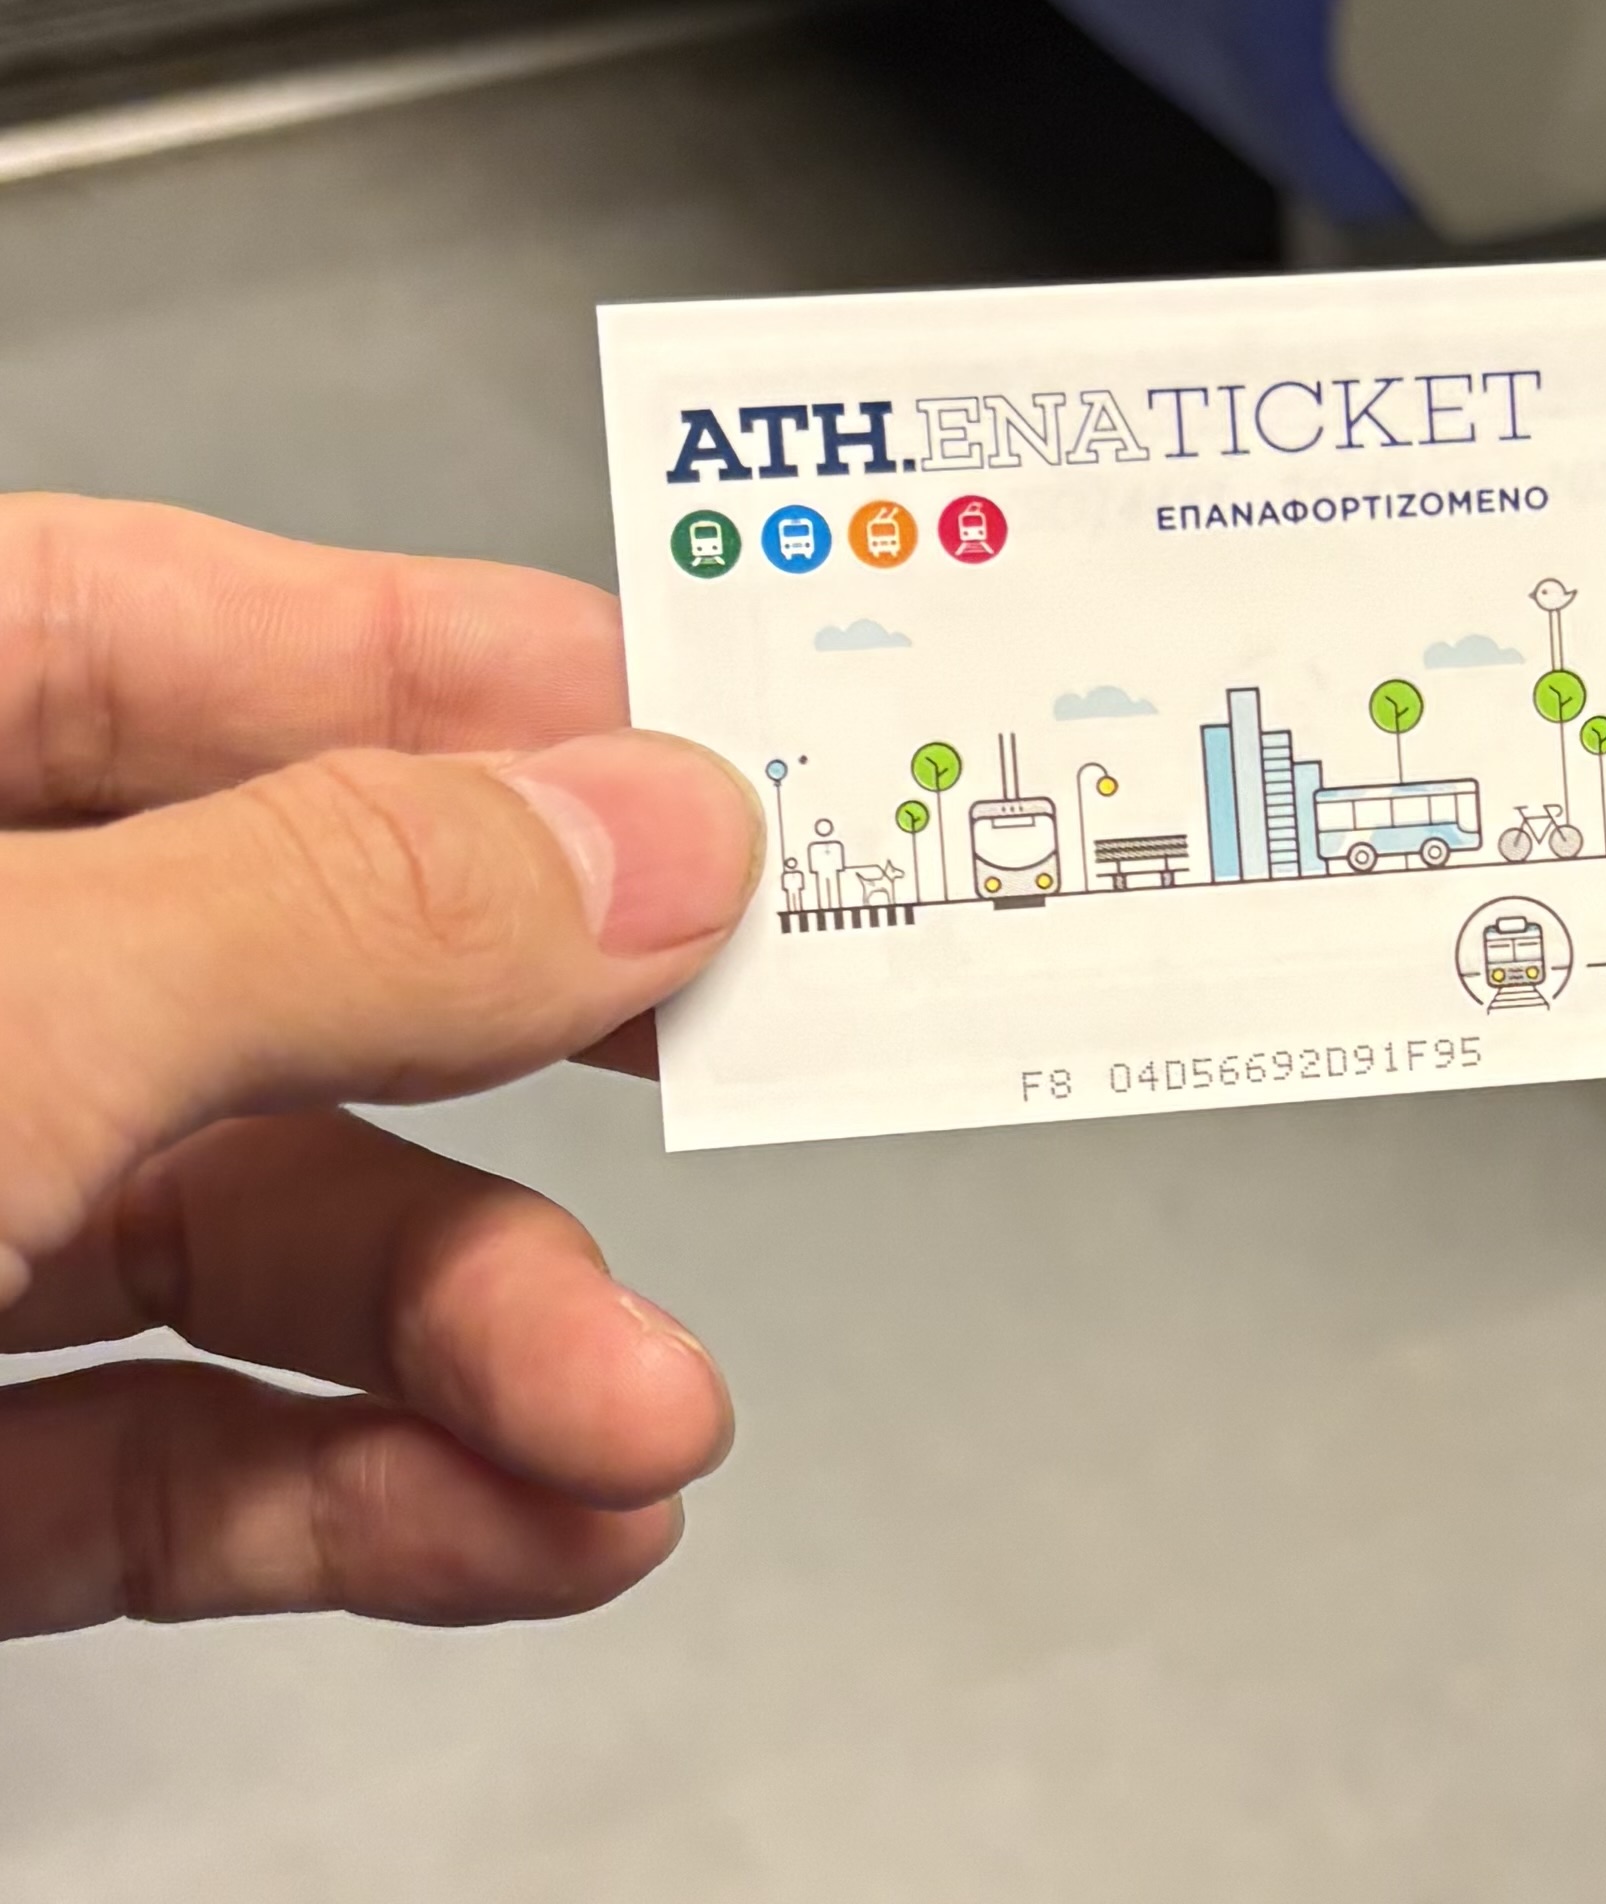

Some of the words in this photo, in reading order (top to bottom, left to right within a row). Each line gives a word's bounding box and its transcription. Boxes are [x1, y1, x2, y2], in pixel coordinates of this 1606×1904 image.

[1156, 485, 1549, 531] ΕΠΑΝΑΦΟΡΤΙΖΟΜΕΝΟ
[1022, 1069, 1071, 1102] F8
[1110, 1036, 1481, 1093] 04D56692D91F95
